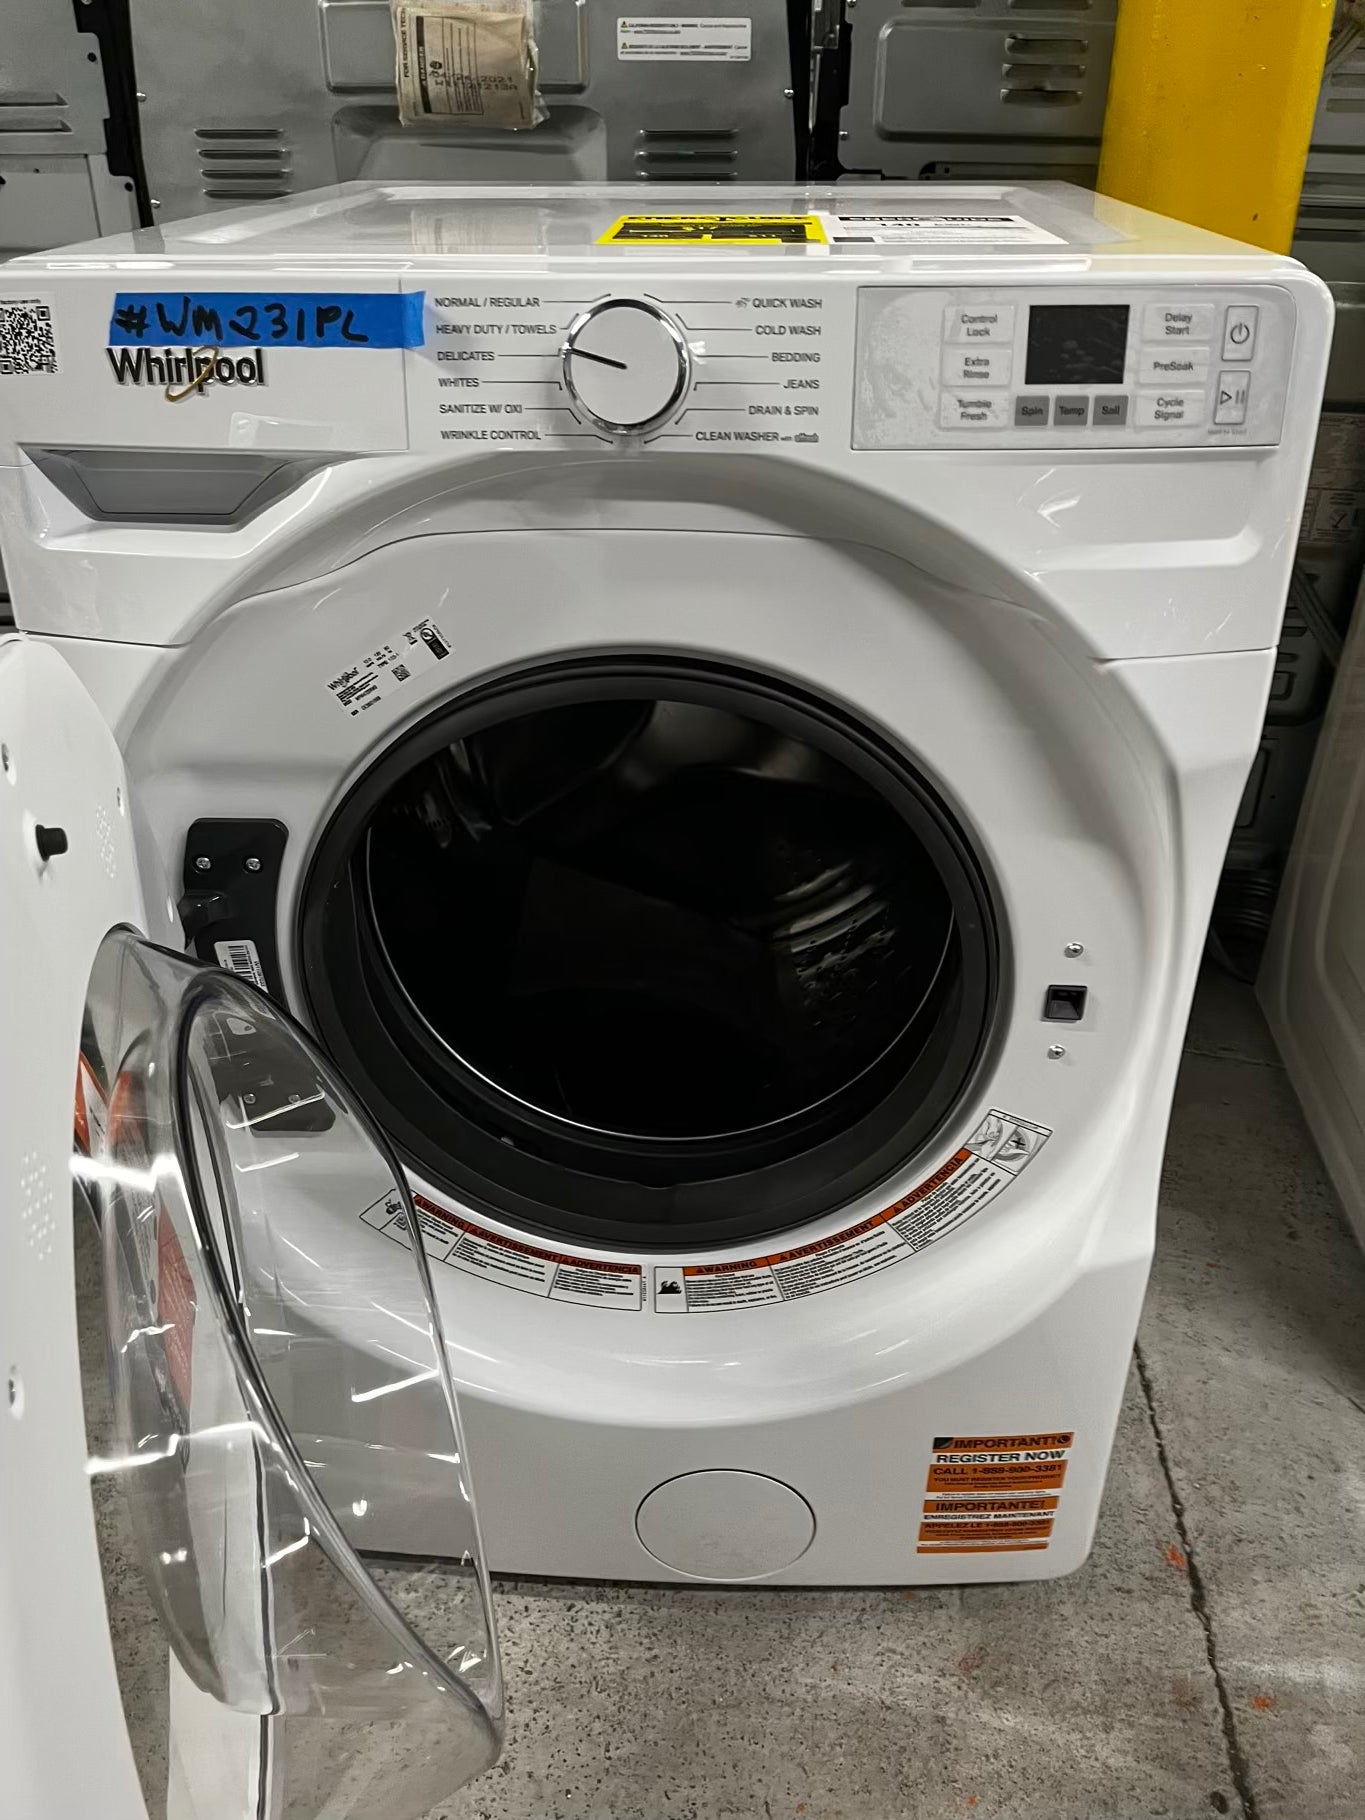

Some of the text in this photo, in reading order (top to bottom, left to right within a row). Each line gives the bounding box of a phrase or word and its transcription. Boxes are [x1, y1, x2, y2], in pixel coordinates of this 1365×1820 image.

[434, 297, 481, 308] NORMAL
[489, 297, 540, 308] REGULAR
[752, 298, 823, 309] QUICK WASH
[961, 314, 998, 325] Control
[1164, 312, 1193, 324] Delay
[436, 325, 472, 334] HEAVY
[473, 325, 503, 334] DUTY
[511, 325, 558, 335] TOWELS
[755, 325, 822, 336] COLD WASH
[966, 327, 991, 337] Lock
[1165, 326, 1190, 336] Start
[437, 351, 496, 361] DELICATES
[771, 352, 822, 363] BEDDING
[964, 357, 990, 367] Extra
[1153, 361, 1194, 371] PreSoak
[105, 347, 266, 398] Whirlpool
[438, 378, 480, 387] WHITES
[783, 379, 820, 390] JEANS
[1156, 397, 1184, 408] Cycle
[439, 404, 487, 414] SANITIZE
[504, 404, 523, 414] OXI
[748, 405, 819, 416] DRAIN & SPIN
[1021, 406, 1043, 416] Spin
[1059, 405, 1085, 416] Temp
[1101, 405, 1121, 415] Soil
[960, 412, 988, 421] Fresh
[1154, 410, 1184, 421] Signal
[440, 430, 542, 441] WRINKLE CONTROL
[695, 431, 732, 441] CLEAN
[733, 431, 780, 442] WASHER
[902, 1156, 963, 1209] ADVERTENCIA
[421, 1200, 464, 1229] WARNING
[475, 1225, 559, 1264] AVERTISSEMENT
[788, 1220, 875, 1260] AVERTISSEMENT
[570, 1257, 640, 1274] ADVERTENCIA
[704, 1260, 757, 1274] WARNING
[936, 1450, 1066, 1464] REGISTER NOW
[933, 1467, 968, 1475] CALL
[993, 1511, 1055, 1519] MAINTENANT
